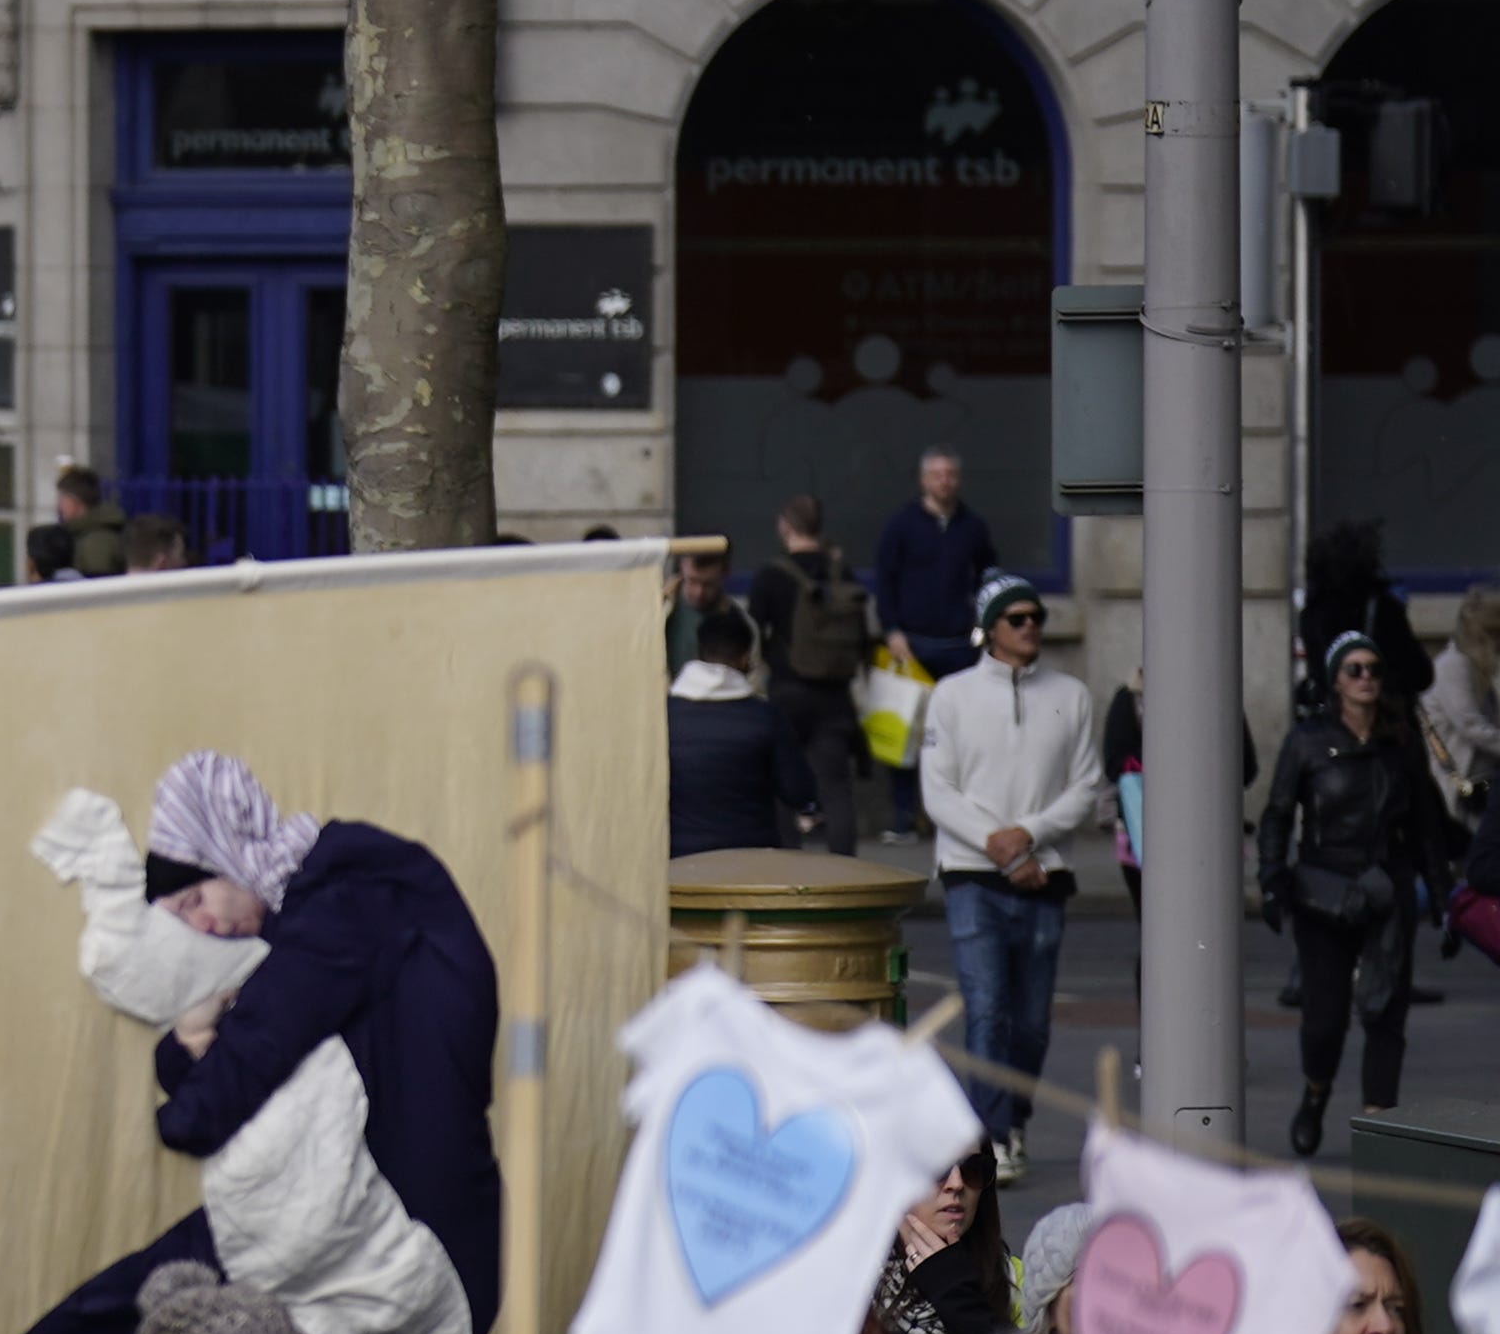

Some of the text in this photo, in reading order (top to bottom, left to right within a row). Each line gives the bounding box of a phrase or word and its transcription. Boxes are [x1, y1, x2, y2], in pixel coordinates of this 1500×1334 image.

[171, 127, 332, 161] permanent
[704, 147, 1021, 195] permanent tsb
[498, 315, 645, 342] permanent tsb
